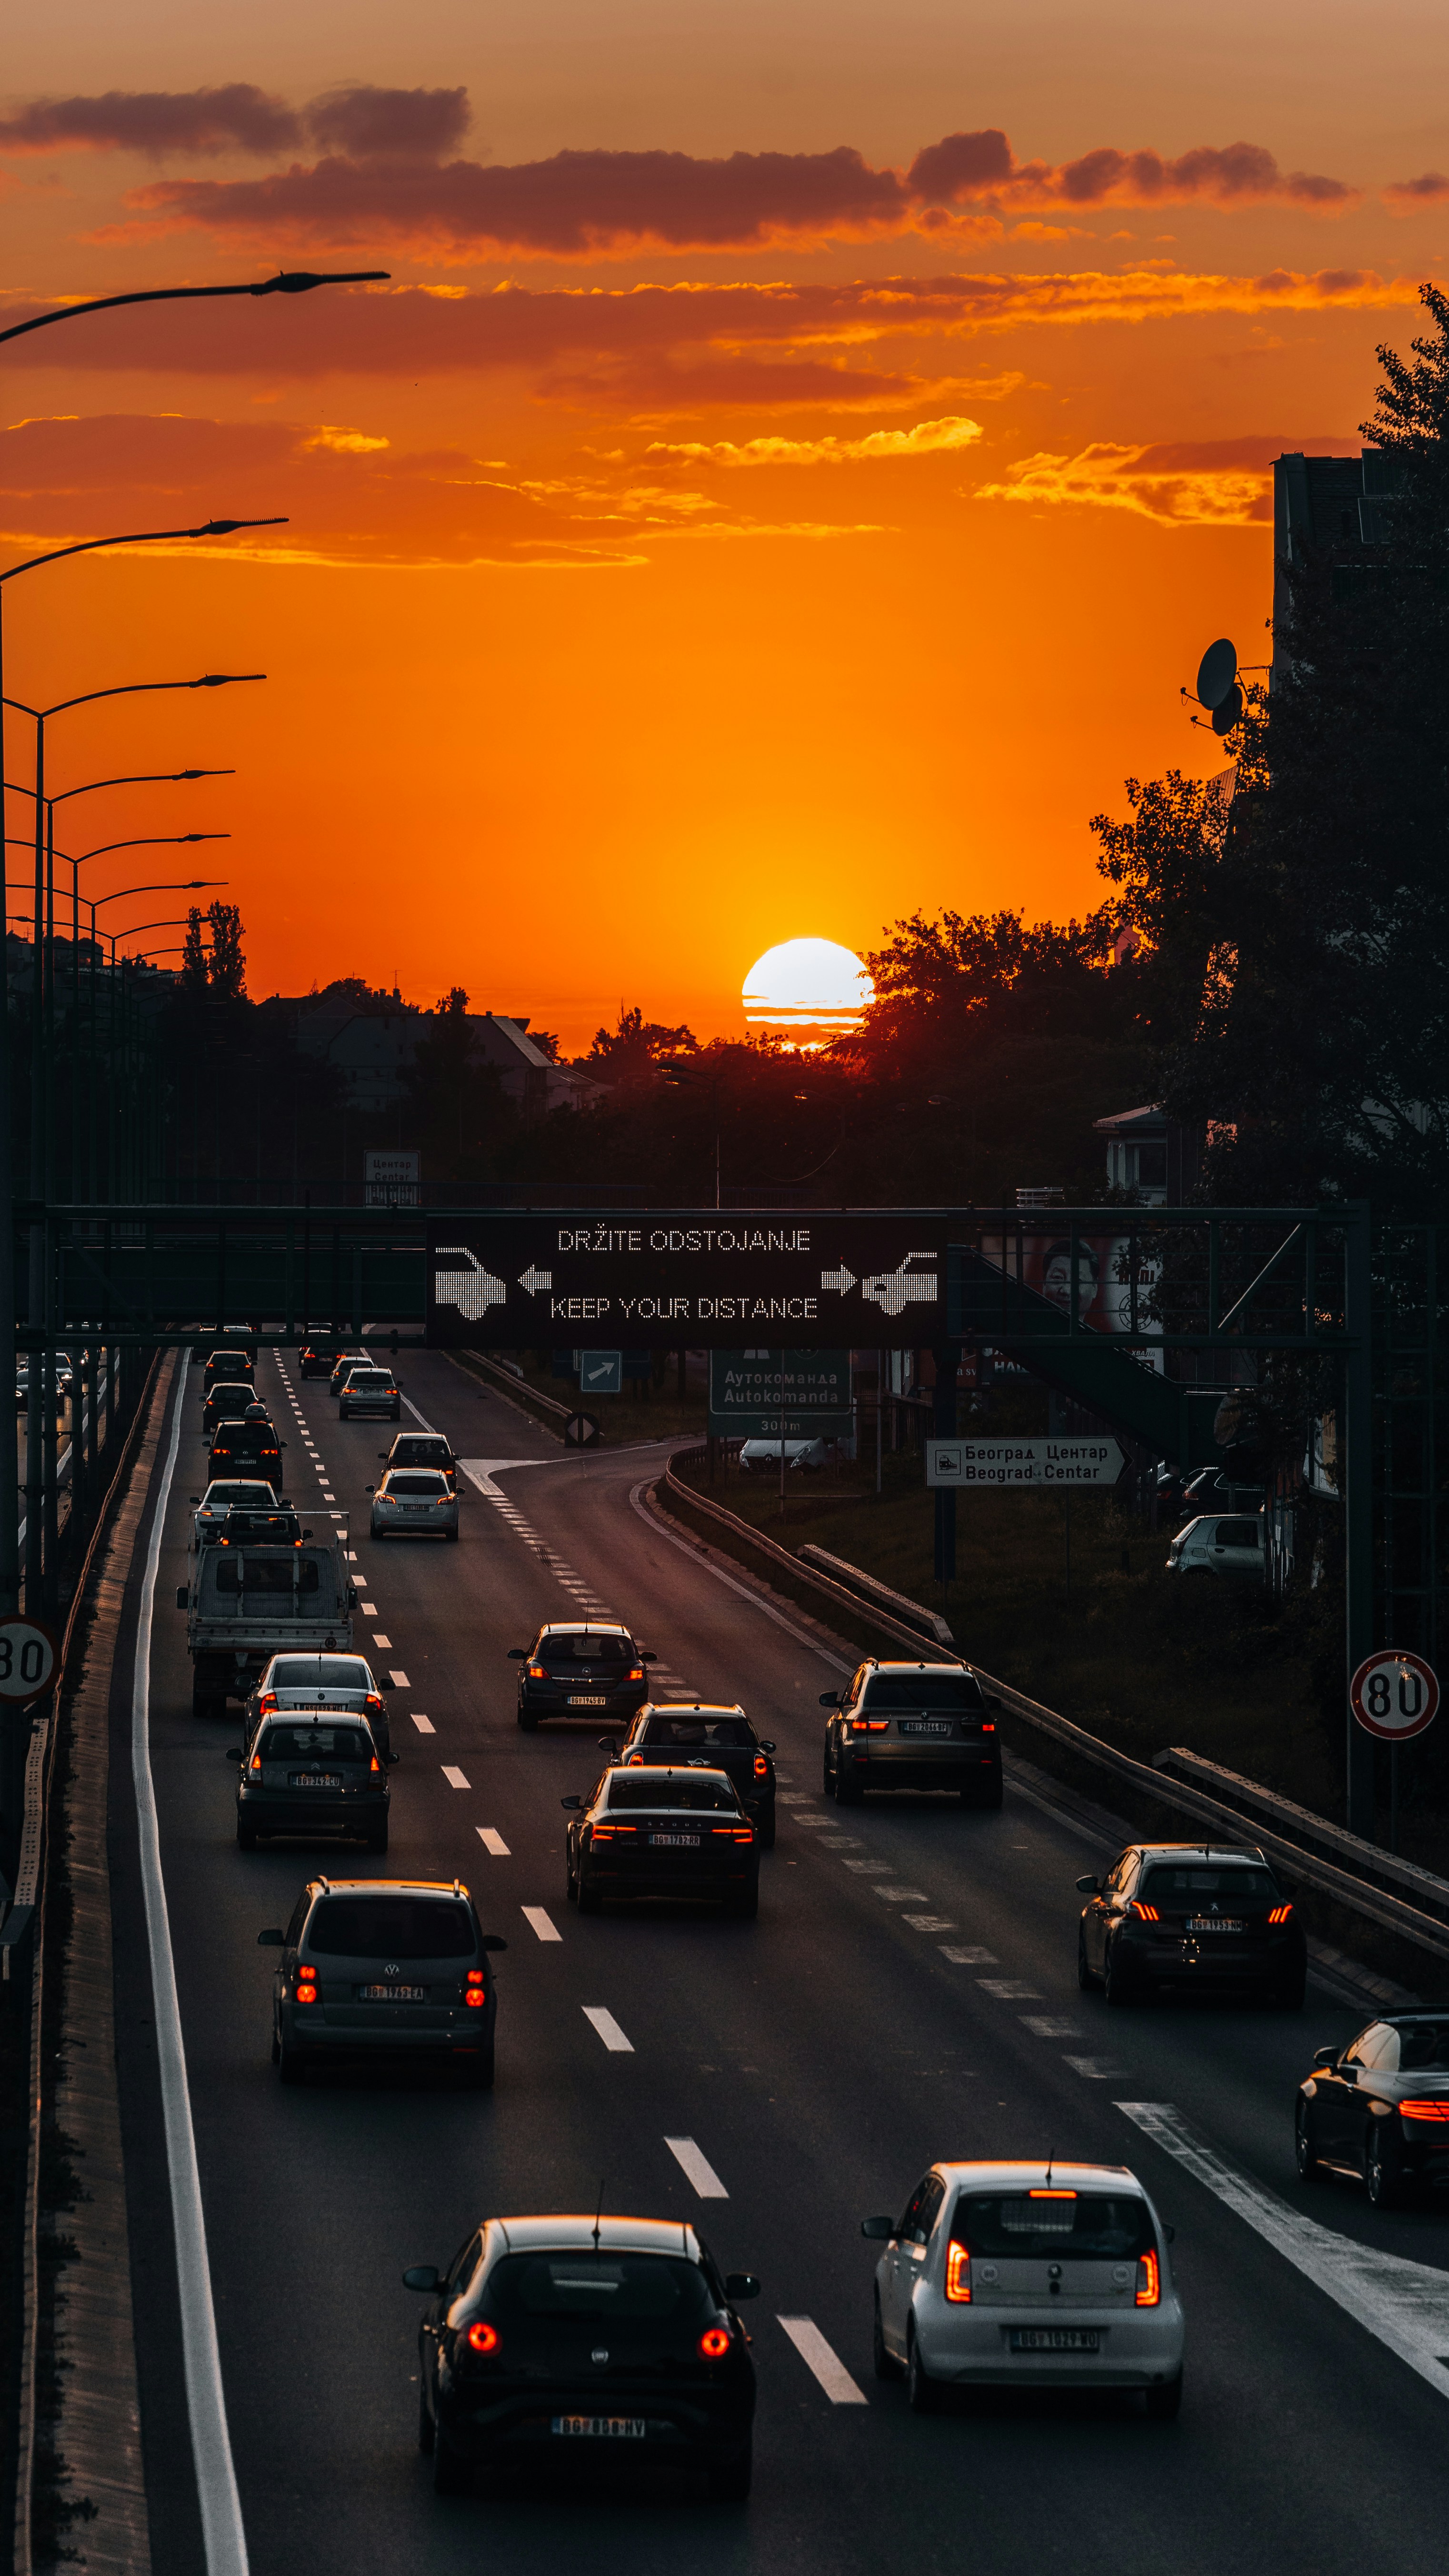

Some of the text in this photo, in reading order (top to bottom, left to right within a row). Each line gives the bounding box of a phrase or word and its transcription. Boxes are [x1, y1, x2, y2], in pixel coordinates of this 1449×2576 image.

[374, 1159, 411, 1169] Центар
[375, 1172, 410, 1180] Centar
[558, 1223, 810, 1251] DRŽITE ODSTOJANJE
[551, 1298, 817, 1318] KEEP YOUR DISTANCE
[725, 1370, 837, 1387] Аутокоманда
[724, 1389, 838, 1403] Autokomanda
[966, 1445, 1108, 1463] Београд Центар
[966, 1464, 1099, 1483] Beograd Centar
[1368, 1672, 1421, 1717] 80
